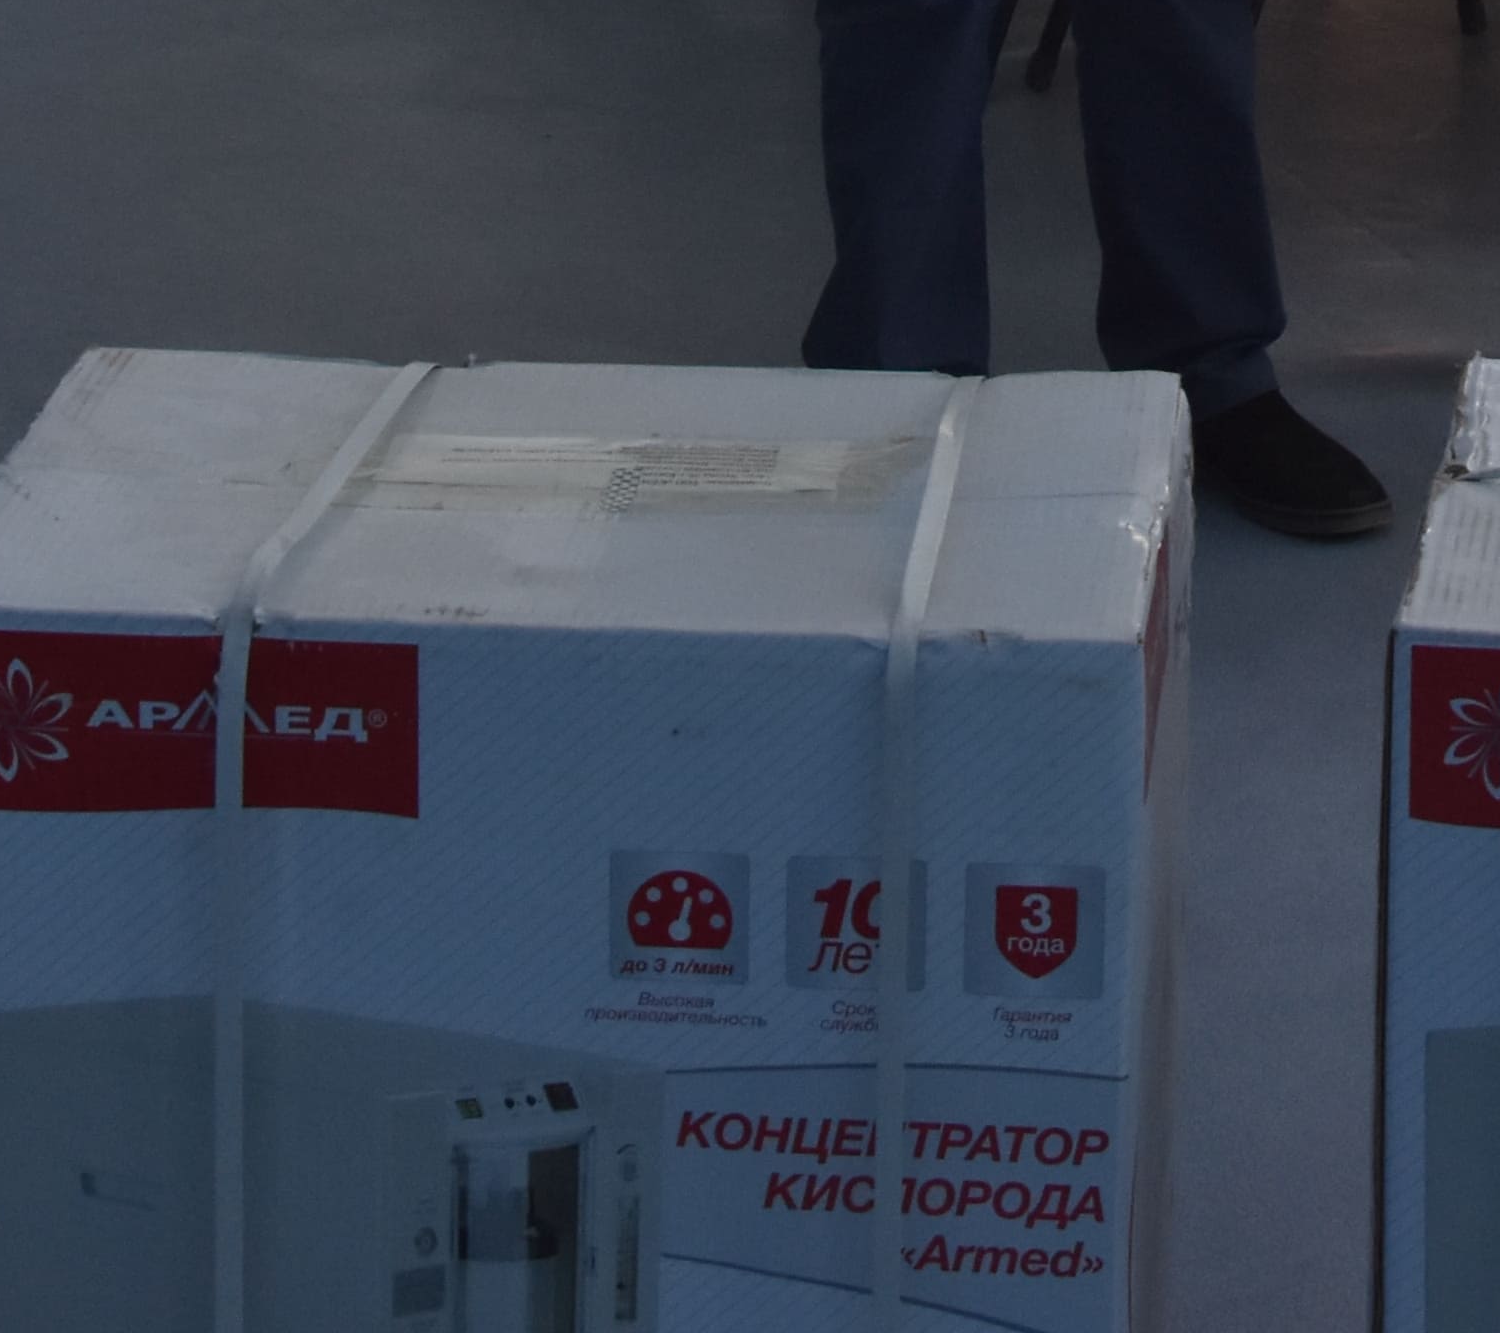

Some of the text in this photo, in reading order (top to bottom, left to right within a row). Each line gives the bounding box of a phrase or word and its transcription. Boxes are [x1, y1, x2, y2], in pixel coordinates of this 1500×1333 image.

[1021, 893, 1053, 934] 3
[1007, 937, 1065, 957] года
[807, 941, 881, 974] ле
[619, 958, 735, 976] до 3 л/мин
[638, 991, 715, 1008] Высокая
[584, 1007, 768, 1028] производительность
[992, 1007, 1073, 1024] Гарантия
[820, 1018, 879, 1034] служб
[1004, 1024, 1059, 1042] 3 года
